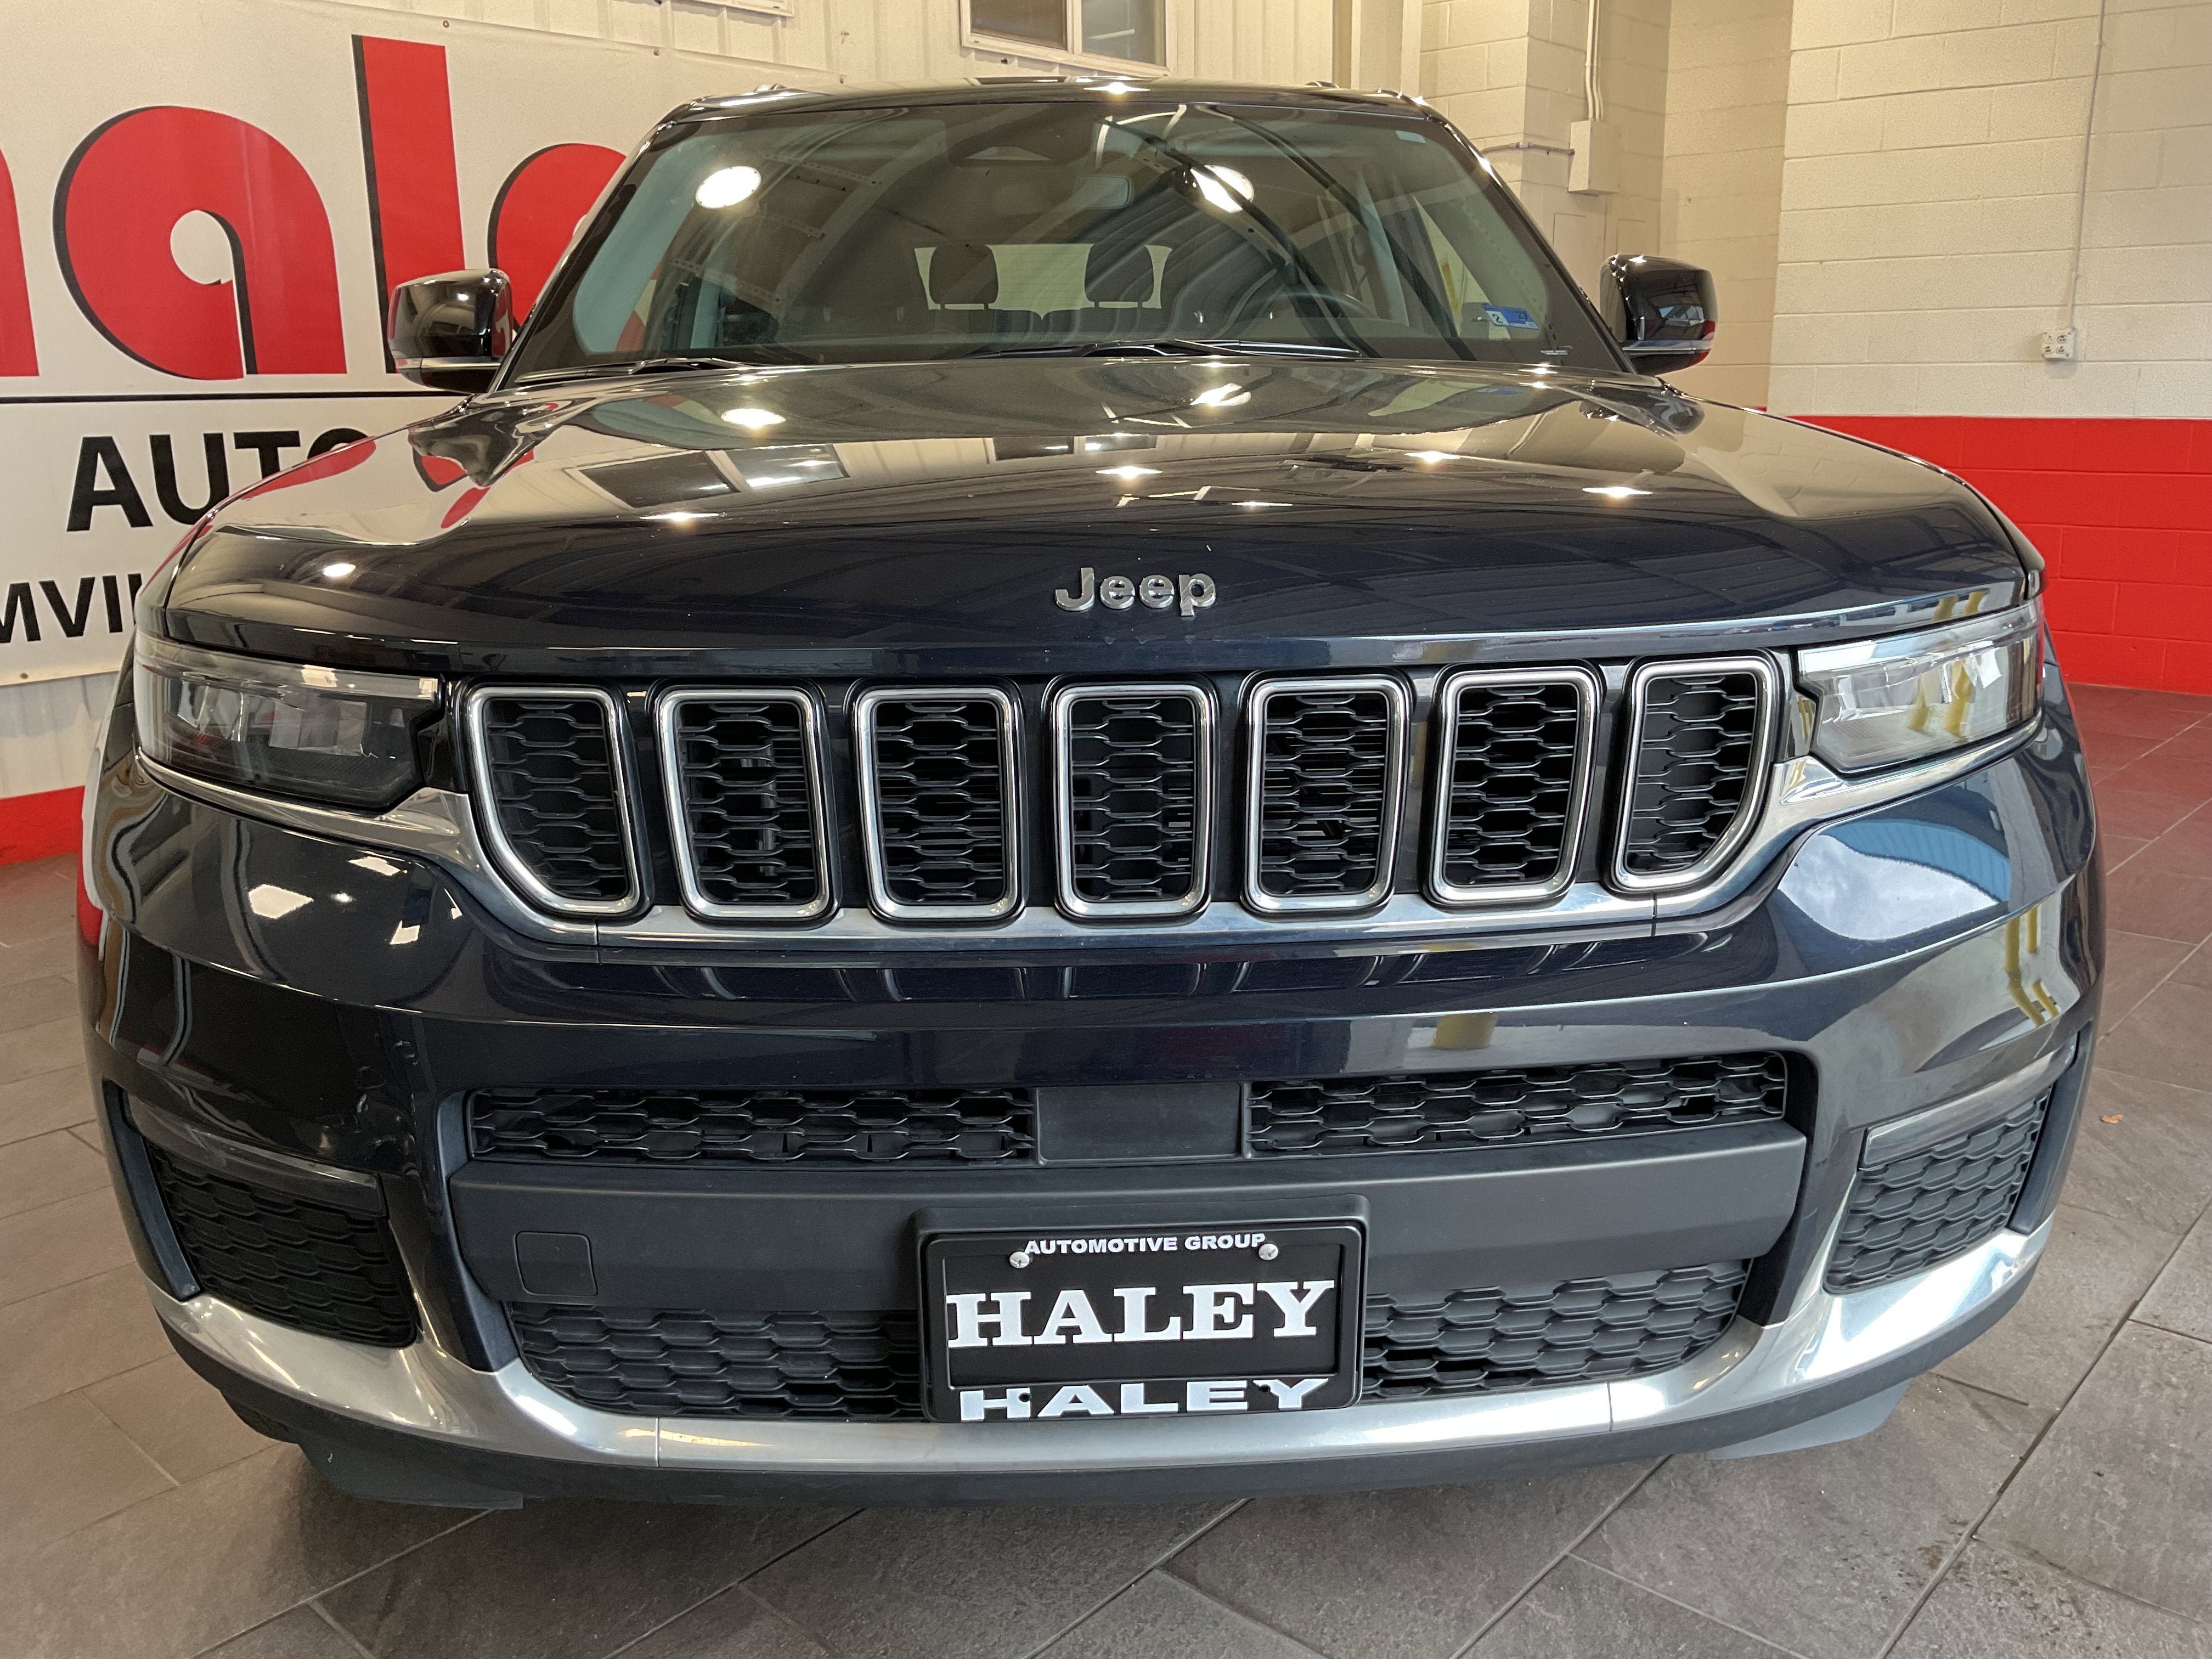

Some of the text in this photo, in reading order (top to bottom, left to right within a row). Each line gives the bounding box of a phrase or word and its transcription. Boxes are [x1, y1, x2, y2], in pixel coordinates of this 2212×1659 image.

[1055, 567, 1216, 617] Jeep
[1024, 1233, 1266, 1255] AUTOMOTIVE GROUP
[945, 1280, 1335, 1348] HALEY
[960, 1378, 1330, 1421] HALEY
